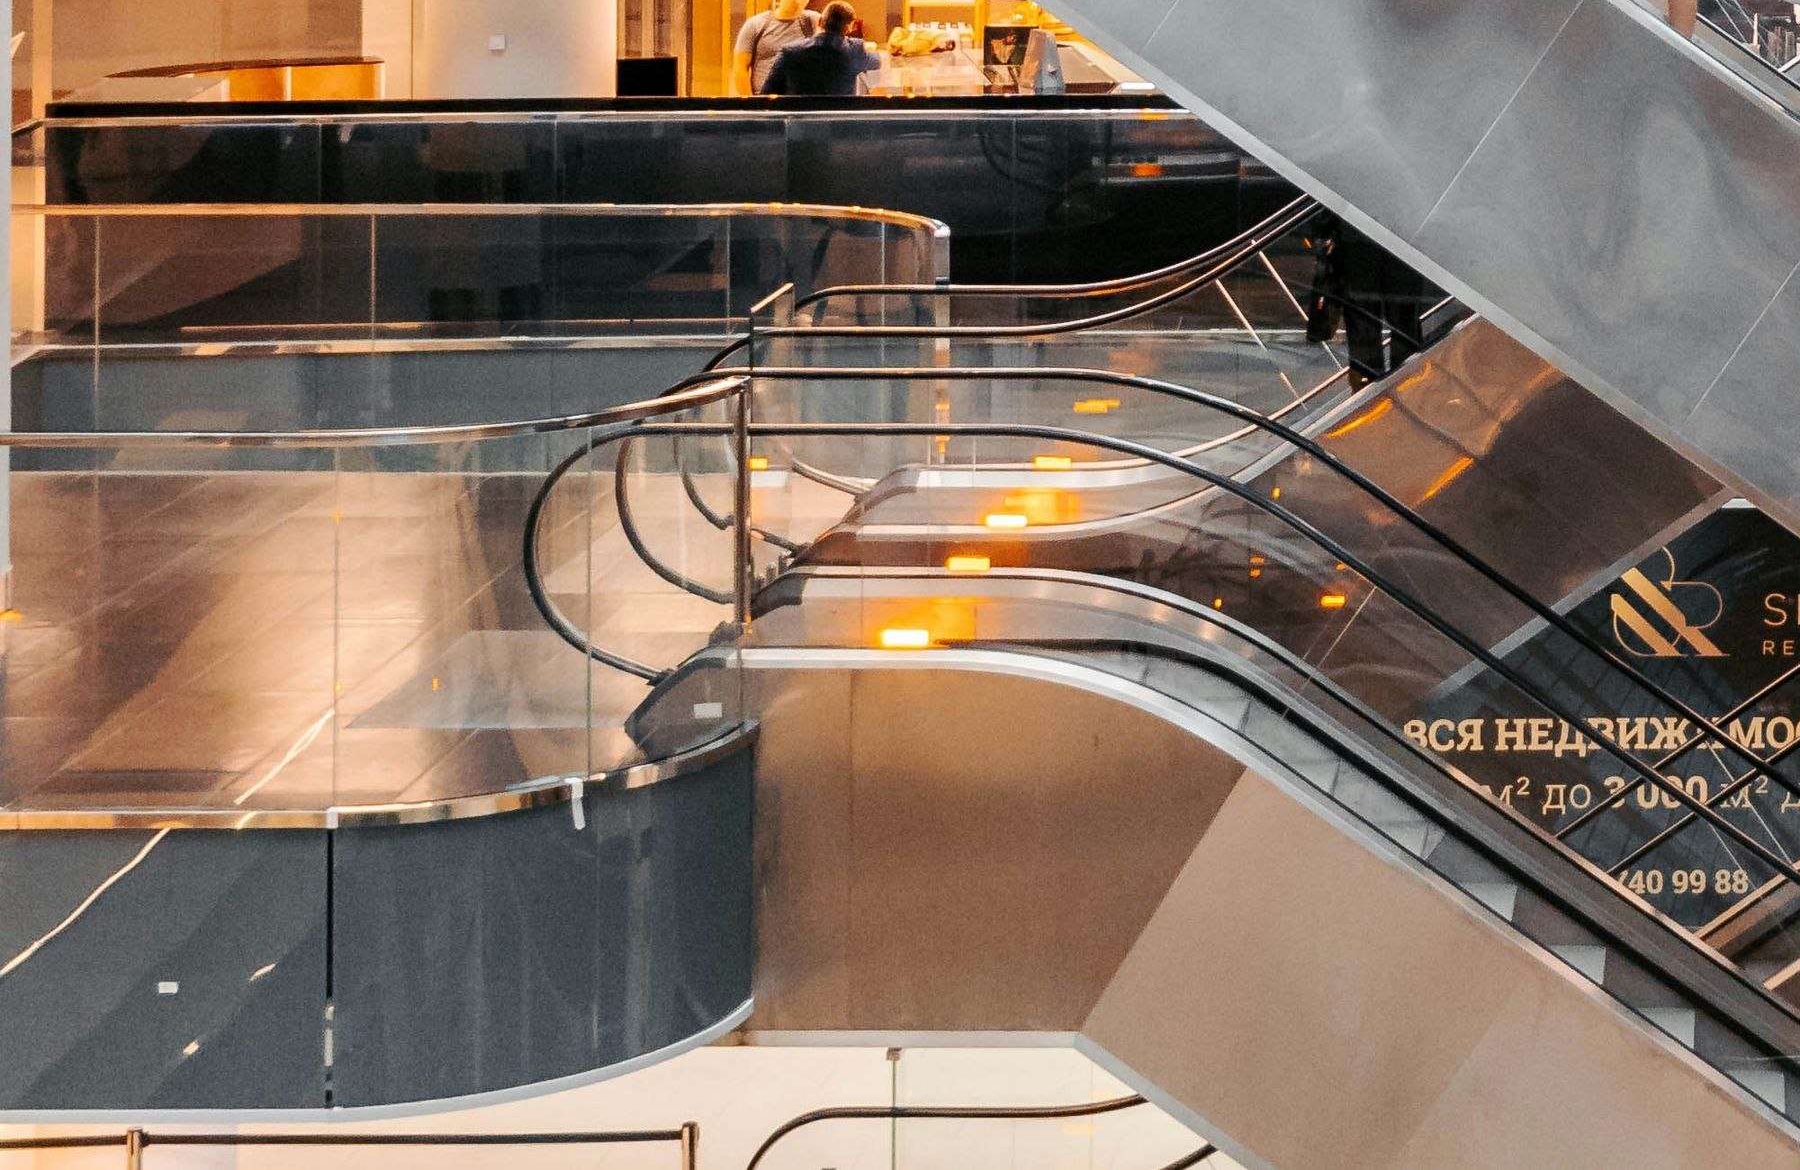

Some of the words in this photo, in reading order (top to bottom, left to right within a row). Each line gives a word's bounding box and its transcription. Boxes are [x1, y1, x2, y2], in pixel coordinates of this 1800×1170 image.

[1402, 718, 1485, 753] ВСЯ
[1541, 783, 1592, 816] до
[1671, 869, 1707, 895] 99
[1714, 869, 1749, 895] 88
